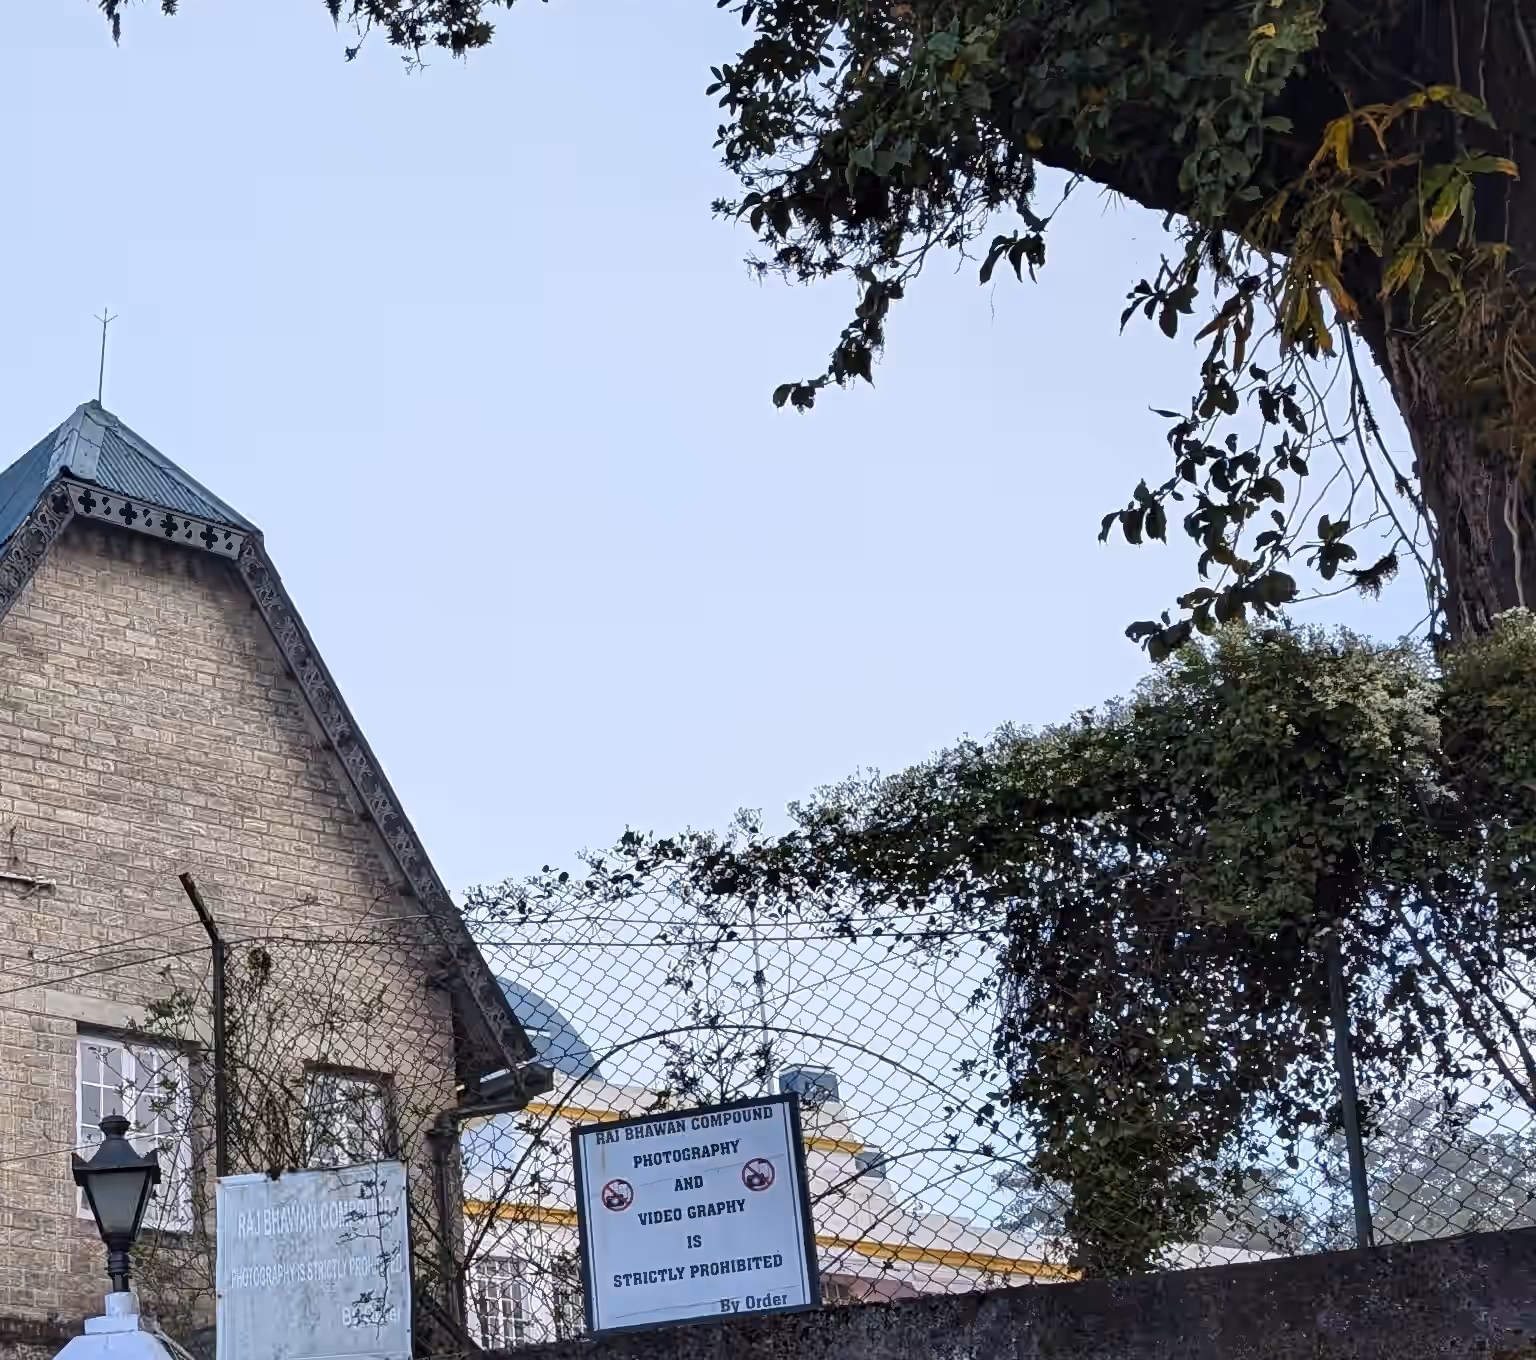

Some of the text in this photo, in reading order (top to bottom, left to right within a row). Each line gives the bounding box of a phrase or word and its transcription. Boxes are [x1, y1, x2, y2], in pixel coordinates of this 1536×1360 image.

[596, 1106, 773, 1145] RAJ BHAWAN COMPOUND
[633, 1139, 740, 1168] PHOTOGRAPHY
[675, 1176, 704, 1191] AND
[238, 1209, 260, 1238] RAJ
[638, 1199, 746, 1226] VIDEO GRAPHY
[687, 1235, 702, 1249] IS
[614, 1253, 783, 1288] STRICTLY PROHIBITED
[720, 1293, 788, 1313] By Order
